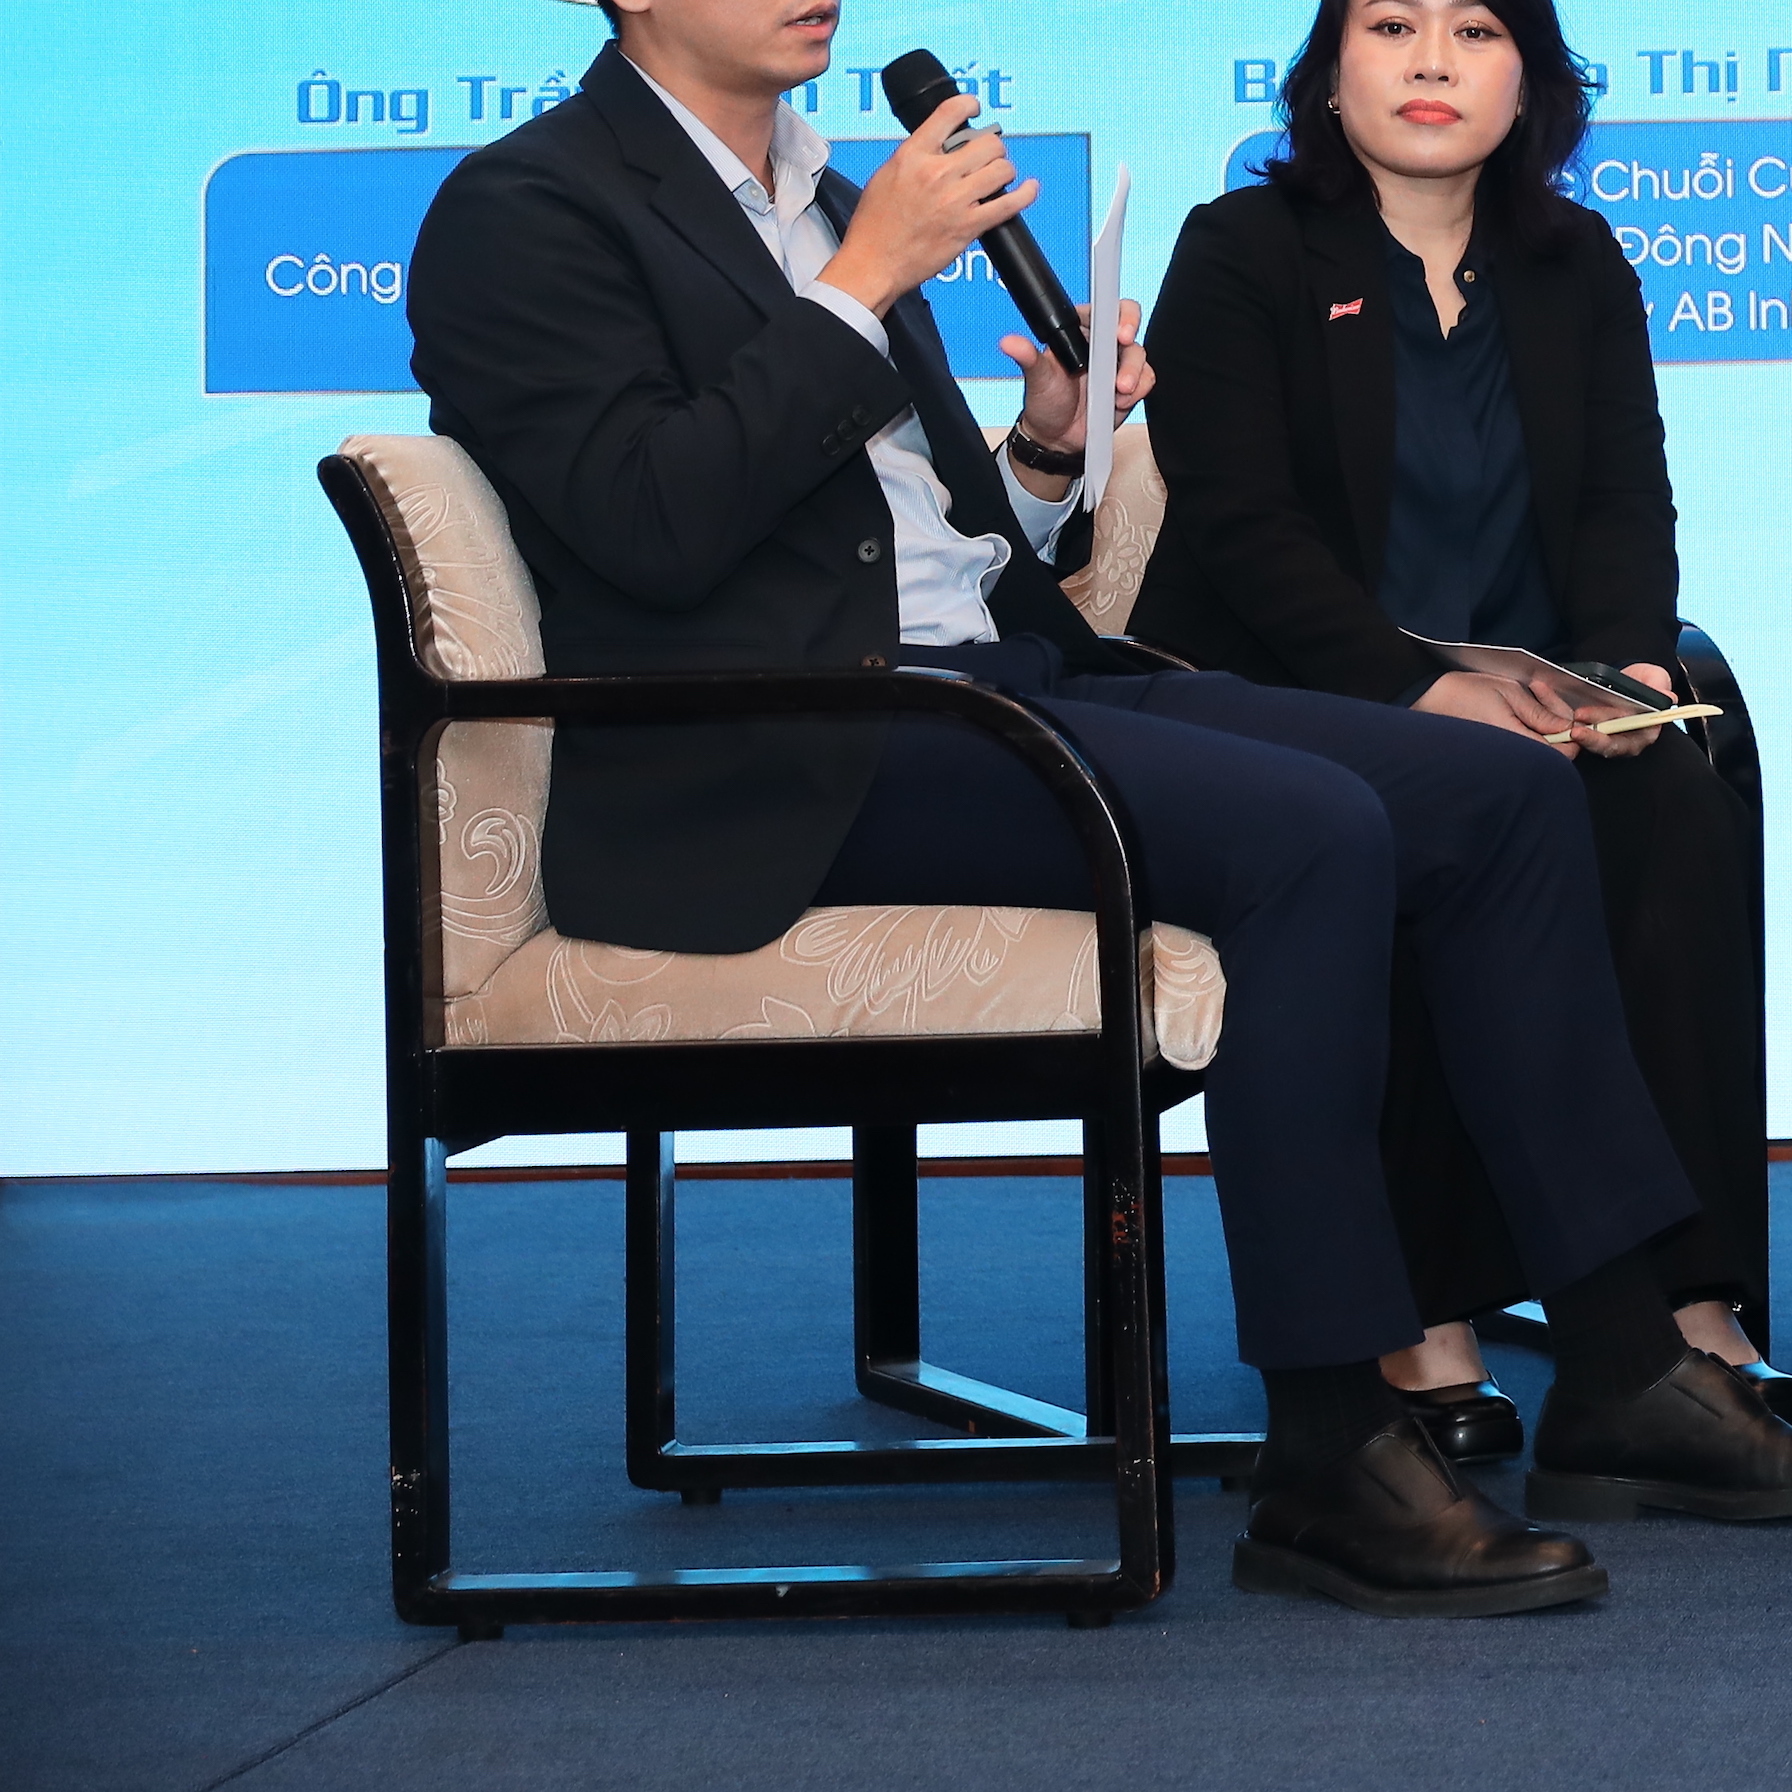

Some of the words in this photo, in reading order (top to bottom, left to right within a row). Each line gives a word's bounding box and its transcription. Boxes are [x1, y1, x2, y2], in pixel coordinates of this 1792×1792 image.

[1637, 49, 1738, 102] Thị
[297, 69, 428, 134] Ông
[456, 70, 587, 119] Trầ
[1591, 151, 1734, 201] Chuỗi
[1614, 223, 1747, 274] Đông
[265, 252, 403, 304] Công
[1667, 289, 1734, 333] AB
